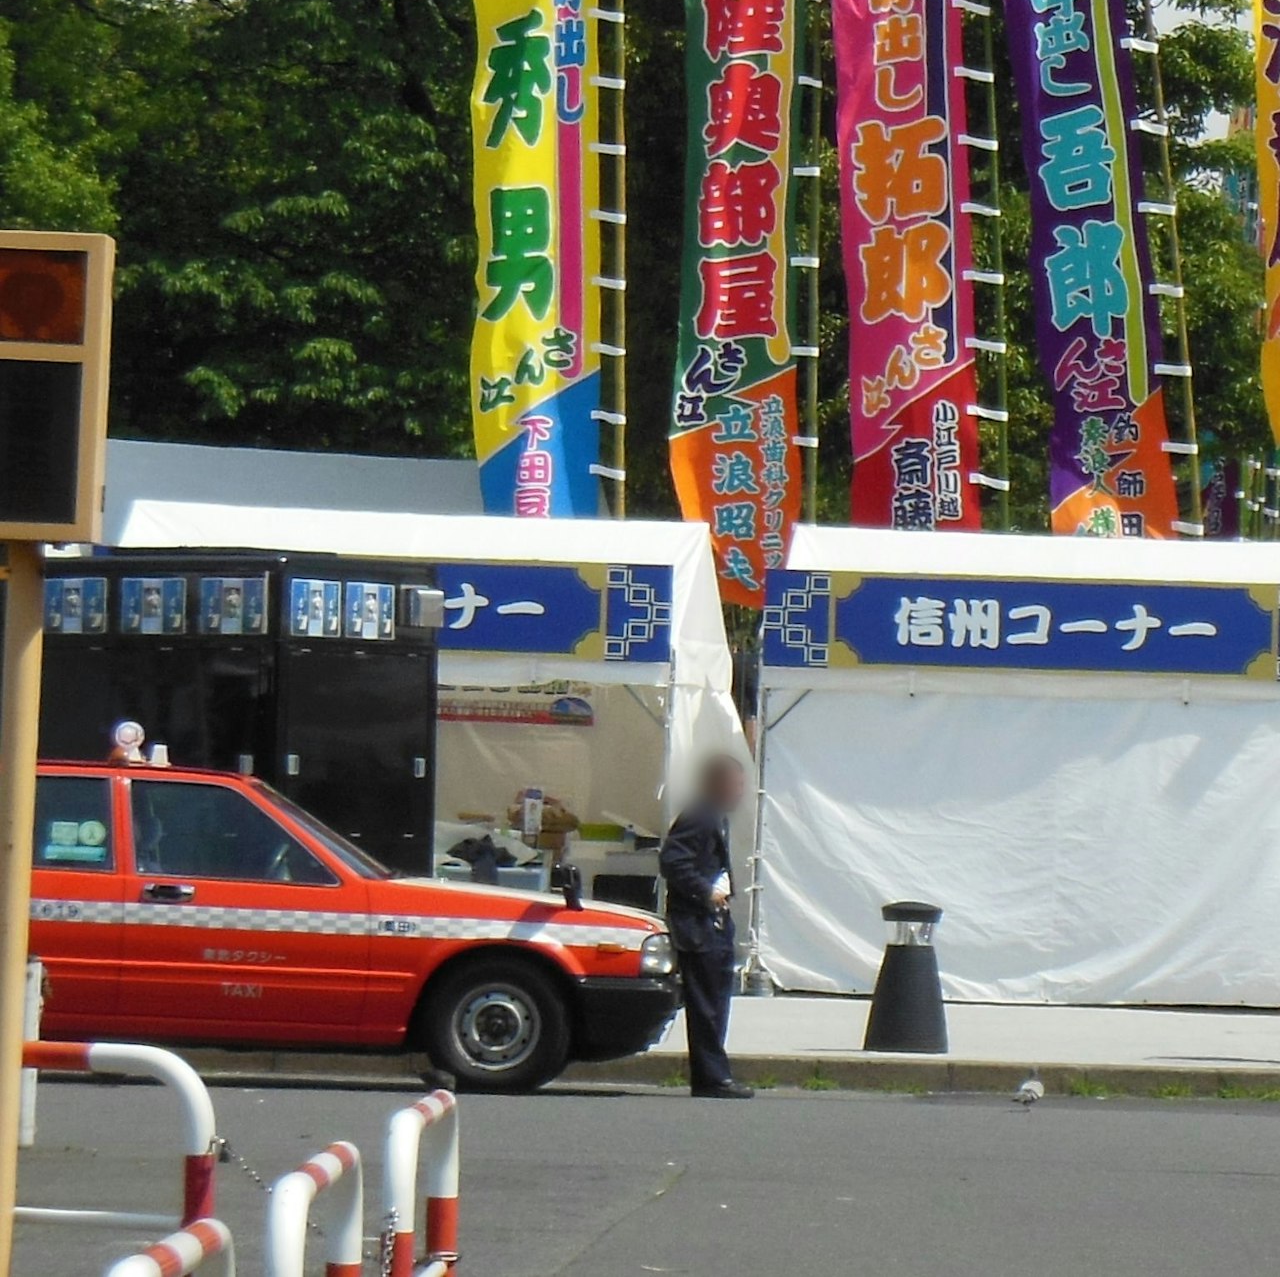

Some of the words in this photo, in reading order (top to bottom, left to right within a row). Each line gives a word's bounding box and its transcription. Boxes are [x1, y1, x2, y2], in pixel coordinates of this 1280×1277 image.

[482, 10, 554, 323] 秀男
[854, 115, 951, 326] 拓郎
[1040, 105, 1130, 340] 吾郎
[712, 404, 760, 591] 立浪昭夫
[760, 394, 791, 574] 立浪歯科クリニッ
[932, 399, 962, 521] 小江戸川越
[894, 597, 1218, 651] 信州コーナー
[222, 982, 263, 998] TAXI
